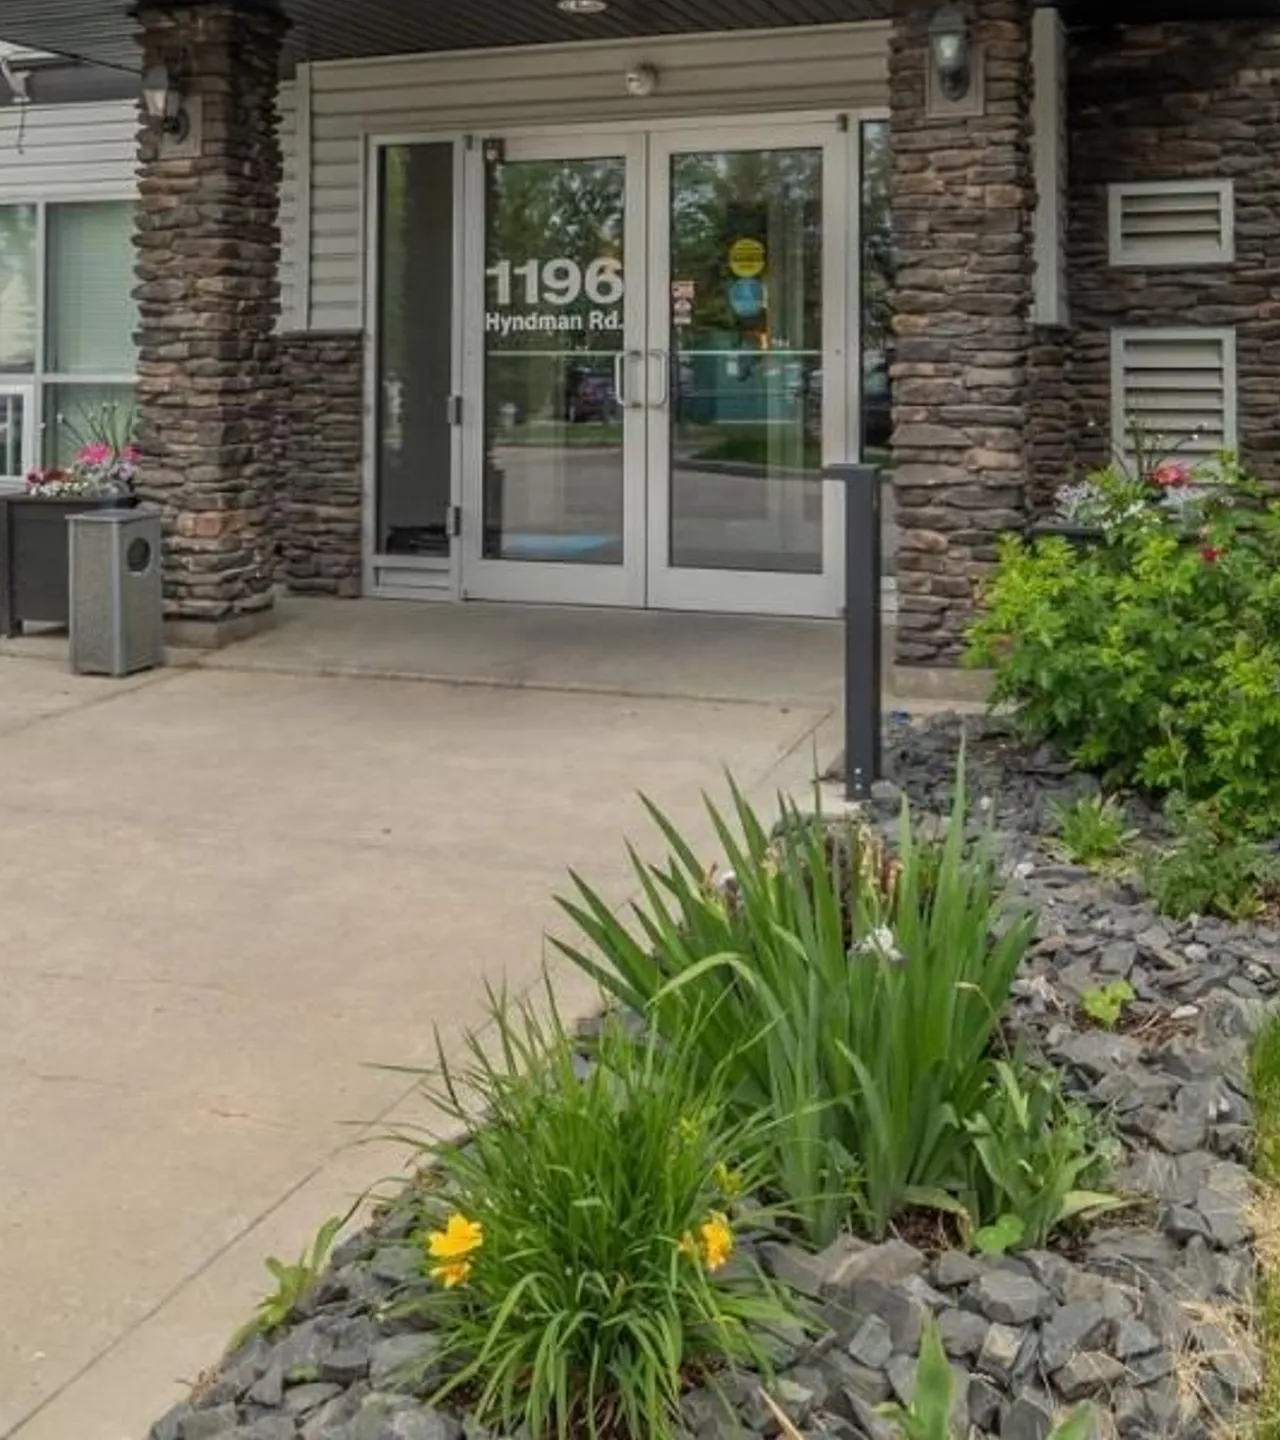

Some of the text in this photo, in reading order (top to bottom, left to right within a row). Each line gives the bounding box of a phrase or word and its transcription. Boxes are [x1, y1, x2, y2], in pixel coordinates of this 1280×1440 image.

[486, 257, 624, 305] 1196
[486, 310, 624, 336] Hyndman Rd.
